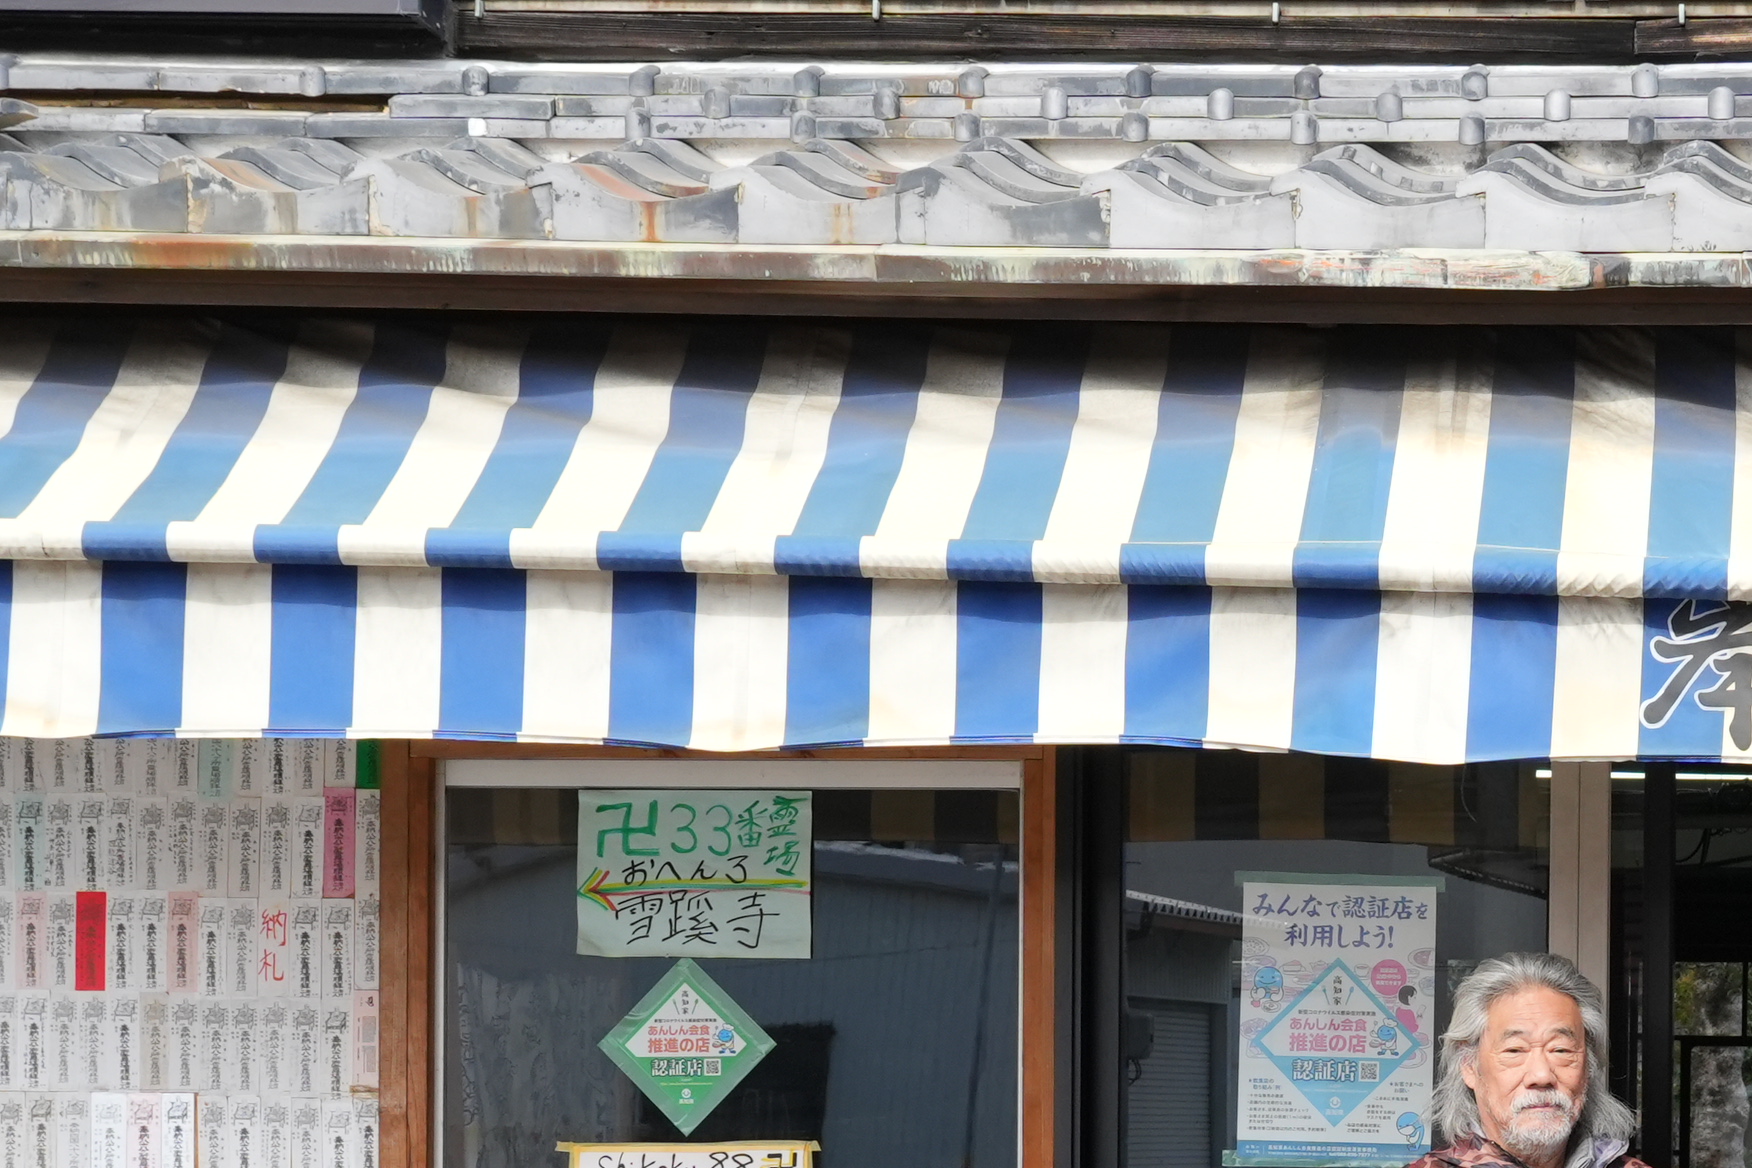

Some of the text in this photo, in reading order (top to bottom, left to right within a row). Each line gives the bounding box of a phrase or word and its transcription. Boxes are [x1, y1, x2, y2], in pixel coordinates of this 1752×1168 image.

[622, 856, 748, 886] おへんろ
[1252, 892, 1428, 920] みんなで認証店を
[648, 1024, 710, 1036] あんしん会食
[1289, 1017, 1367, 1032] あんしん会食
[648, 1038, 710, 1053] 推進の店
[1289, 1032, 1367, 1053] 推進の店
[651, 1058, 703, 1077] 認証店
[1292, 1058, 1357, 1082] 認証店
